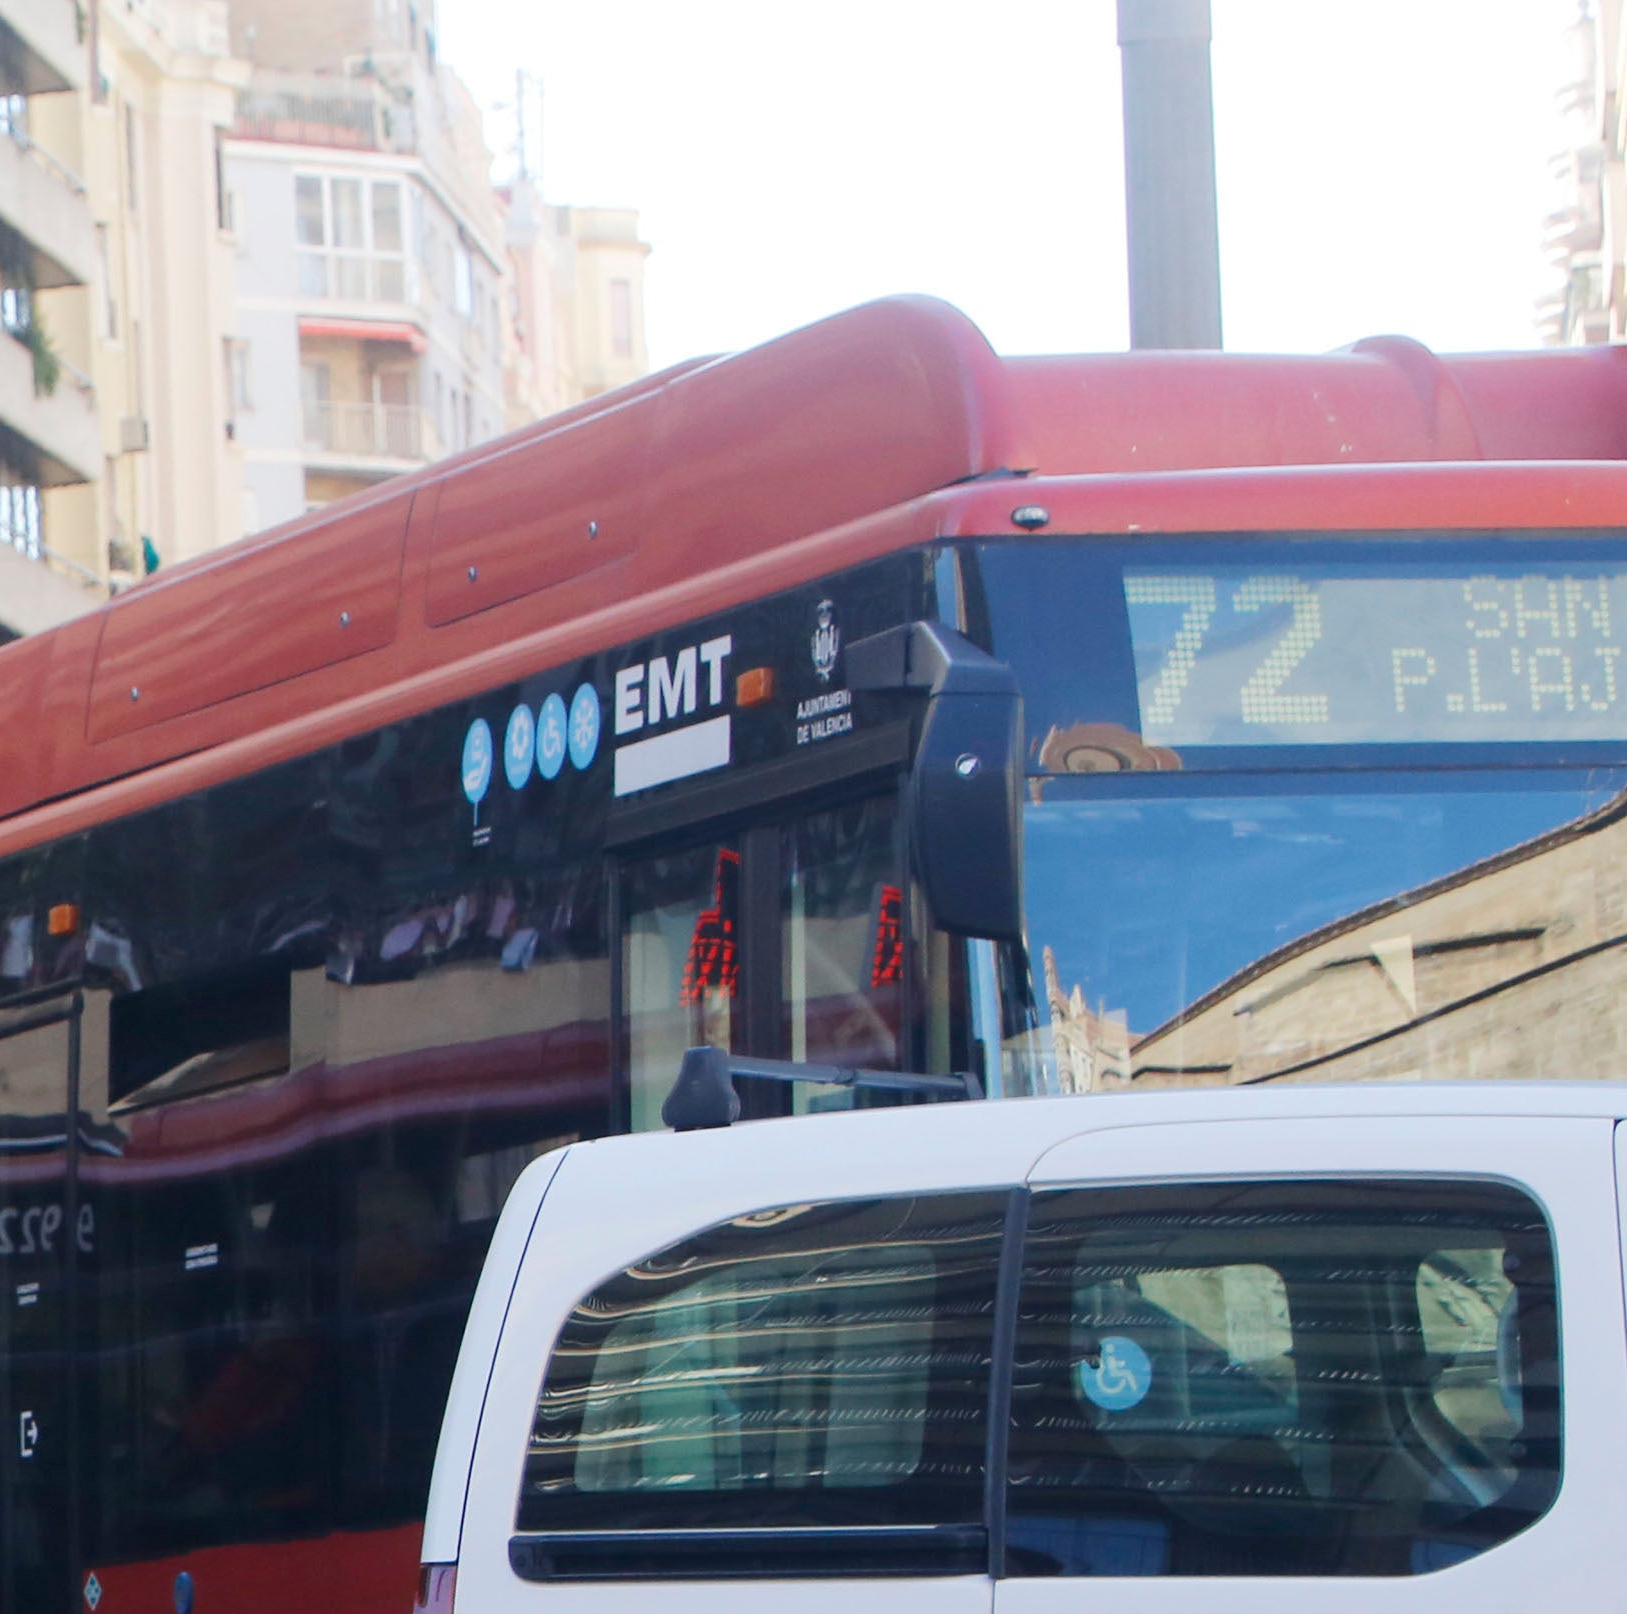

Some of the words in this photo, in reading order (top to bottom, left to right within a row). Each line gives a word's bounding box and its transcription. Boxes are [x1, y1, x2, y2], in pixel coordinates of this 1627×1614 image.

[1123, 576, 1329, 723] 72
[1463, 575, 1627, 638] SAN
[614, 634, 732, 736] EMT
